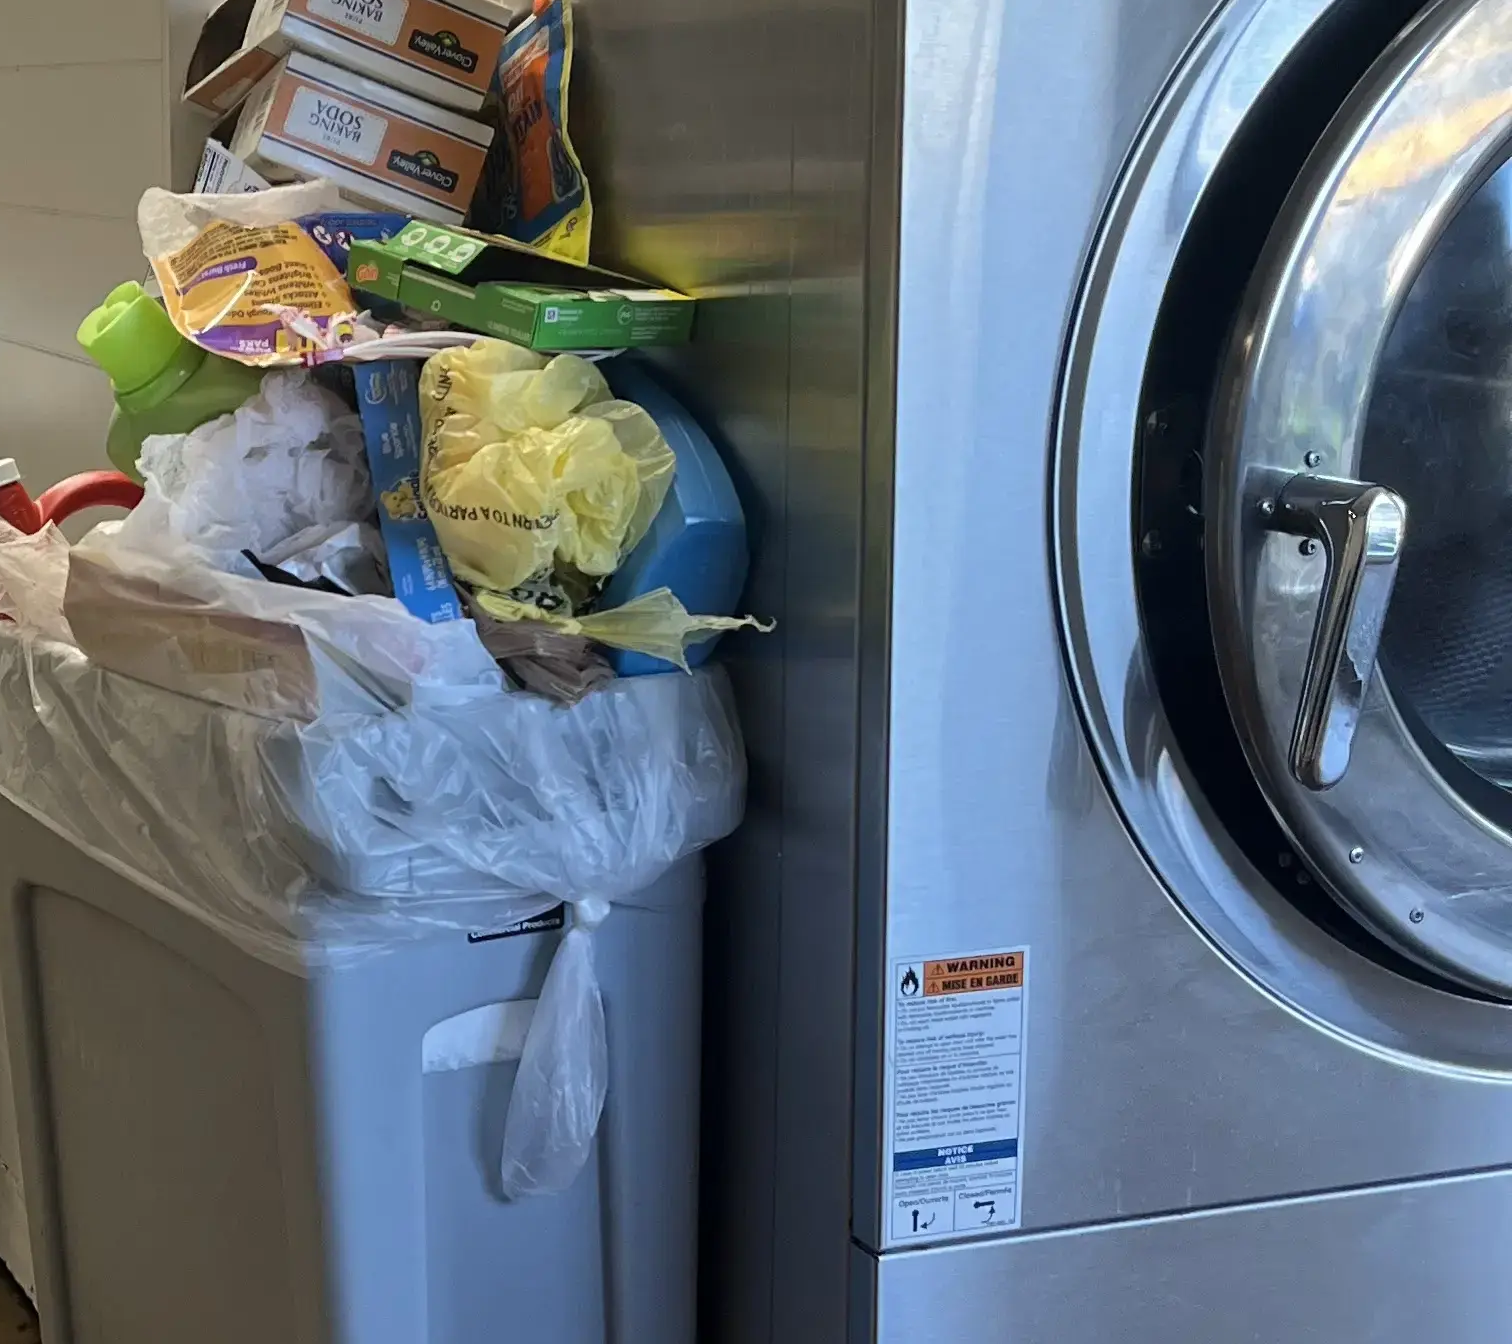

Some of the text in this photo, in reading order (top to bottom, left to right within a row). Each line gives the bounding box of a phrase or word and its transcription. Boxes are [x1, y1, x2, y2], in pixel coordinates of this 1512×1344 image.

[317, 99, 364, 130] SODA
[308, 113, 362, 143] BAKING
[479, 506, 490, 517] A
[492, 509, 509, 526] TO
[947, 956, 1015, 973] WARNING
[942, 973, 1019, 991] MISE EN GARDE
[938, 1145, 974, 1157] NOTICE
[944, 1155, 967, 1165] AVIS
